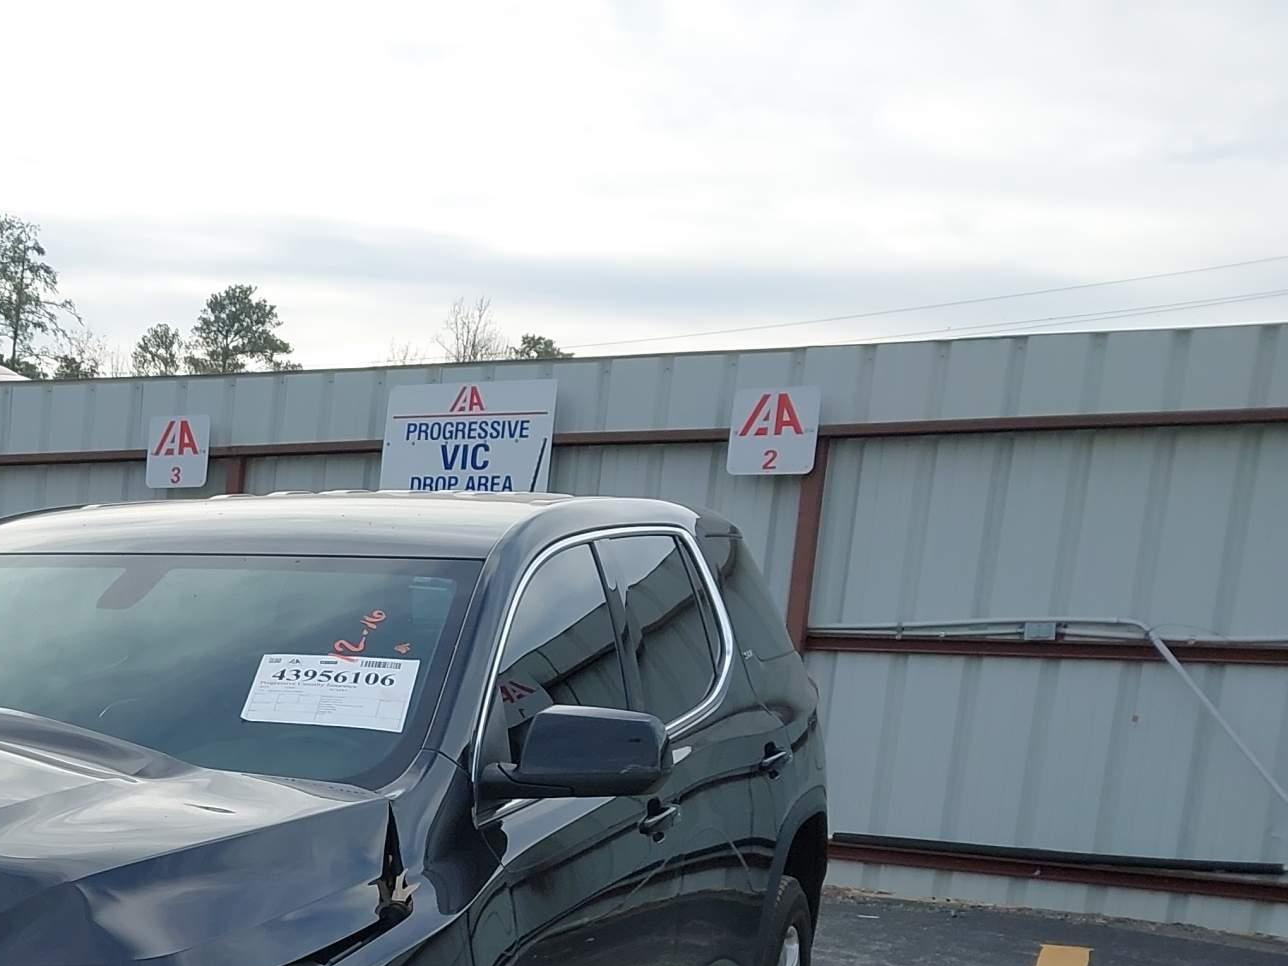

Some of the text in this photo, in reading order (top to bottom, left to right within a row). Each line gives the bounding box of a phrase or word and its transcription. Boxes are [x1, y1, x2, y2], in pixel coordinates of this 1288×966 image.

[406, 419, 531, 441] PROGRESSIVE
[440, 443, 490, 470] VIC
[762, 449, 778, 470] 2
[170, 466, 181, 484] 3
[410, 475, 513, 491] DROP AREA
[271, 668, 396, 687] 43956106
